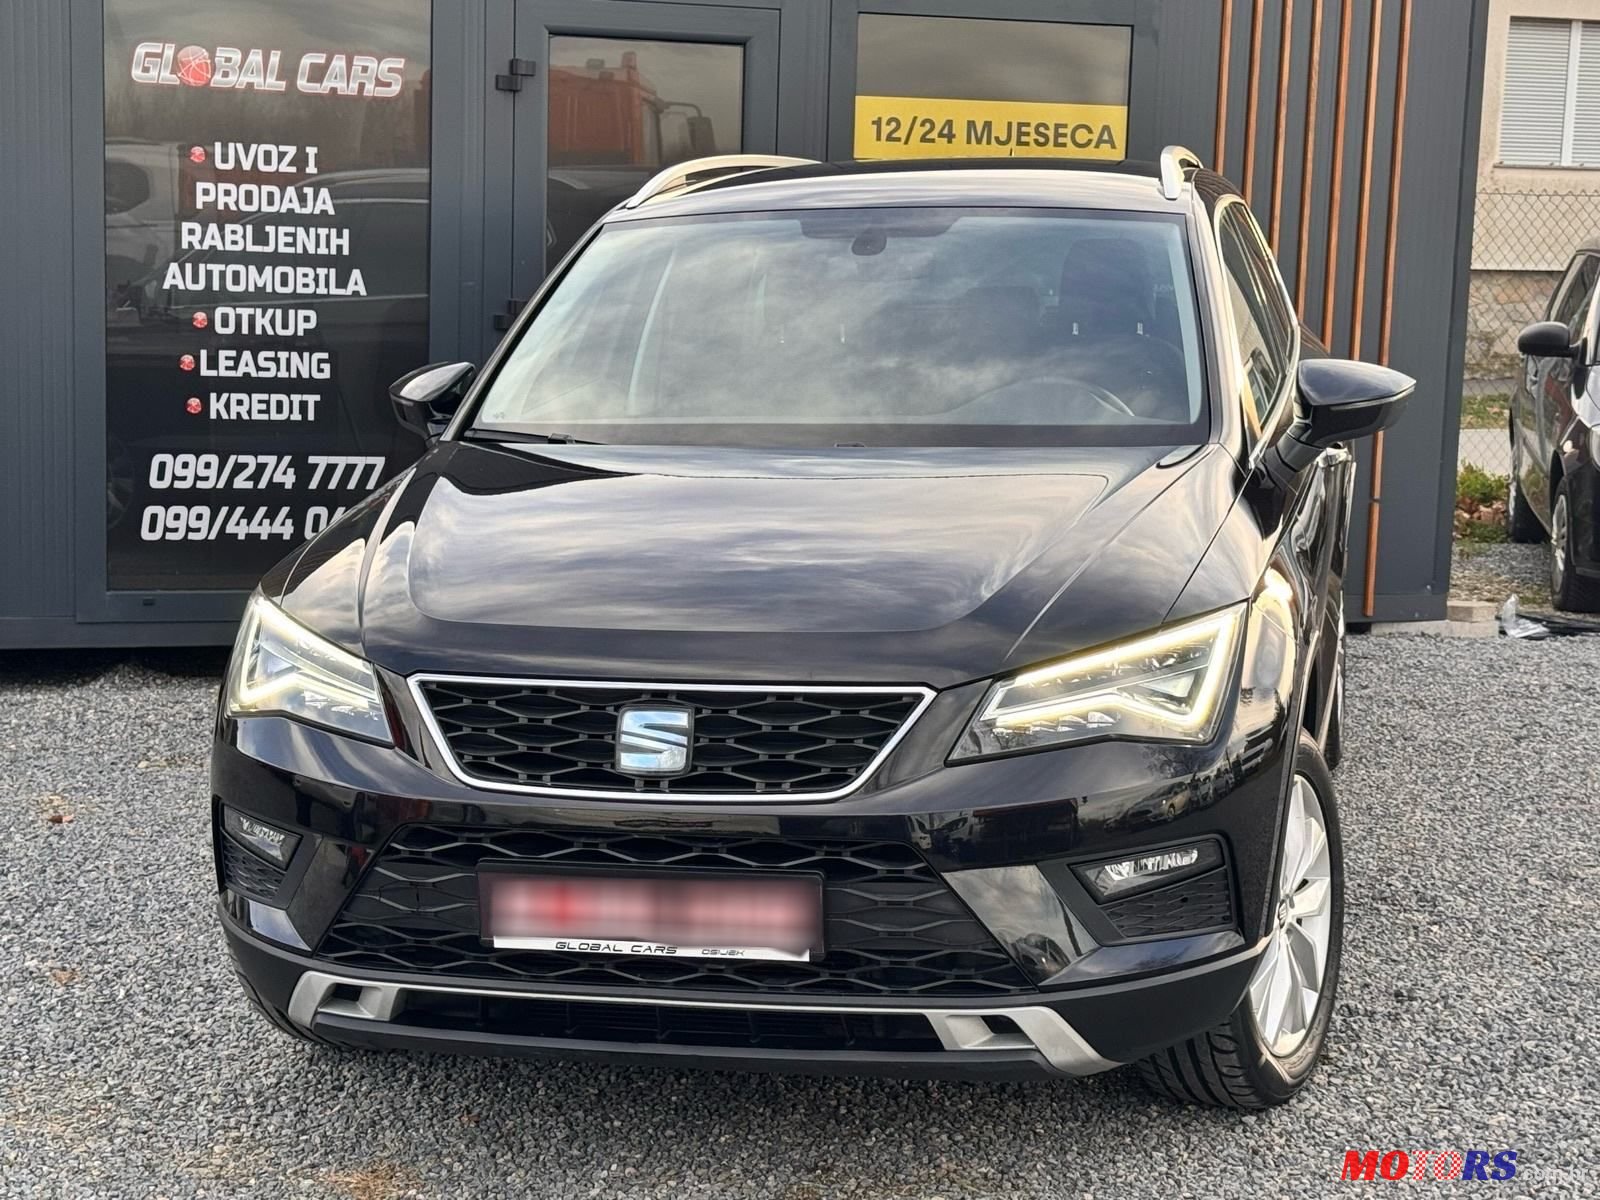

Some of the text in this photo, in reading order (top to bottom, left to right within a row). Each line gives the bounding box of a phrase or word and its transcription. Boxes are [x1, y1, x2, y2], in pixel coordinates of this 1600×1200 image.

[131, 42, 405, 97] GLOBAL CARS
[871, 115, 1117, 150] 12/24 MJESECA
[214, 142, 318, 174] UVOZ I
[195, 182, 335, 215] PRODAJA
[181, 222, 350, 255] RABLJENIH
[162, 262, 367, 296] AUTOMOBILA
[214, 306, 317, 336] OTKUP
[200, 350, 331, 379] LEASING
[209, 393, 321, 421] KREDIT
[149, 453, 385, 490] 099/274 7777
[140, 505, 294, 541] 099/444
[555, 941, 678, 955] GLOBAL CARS
